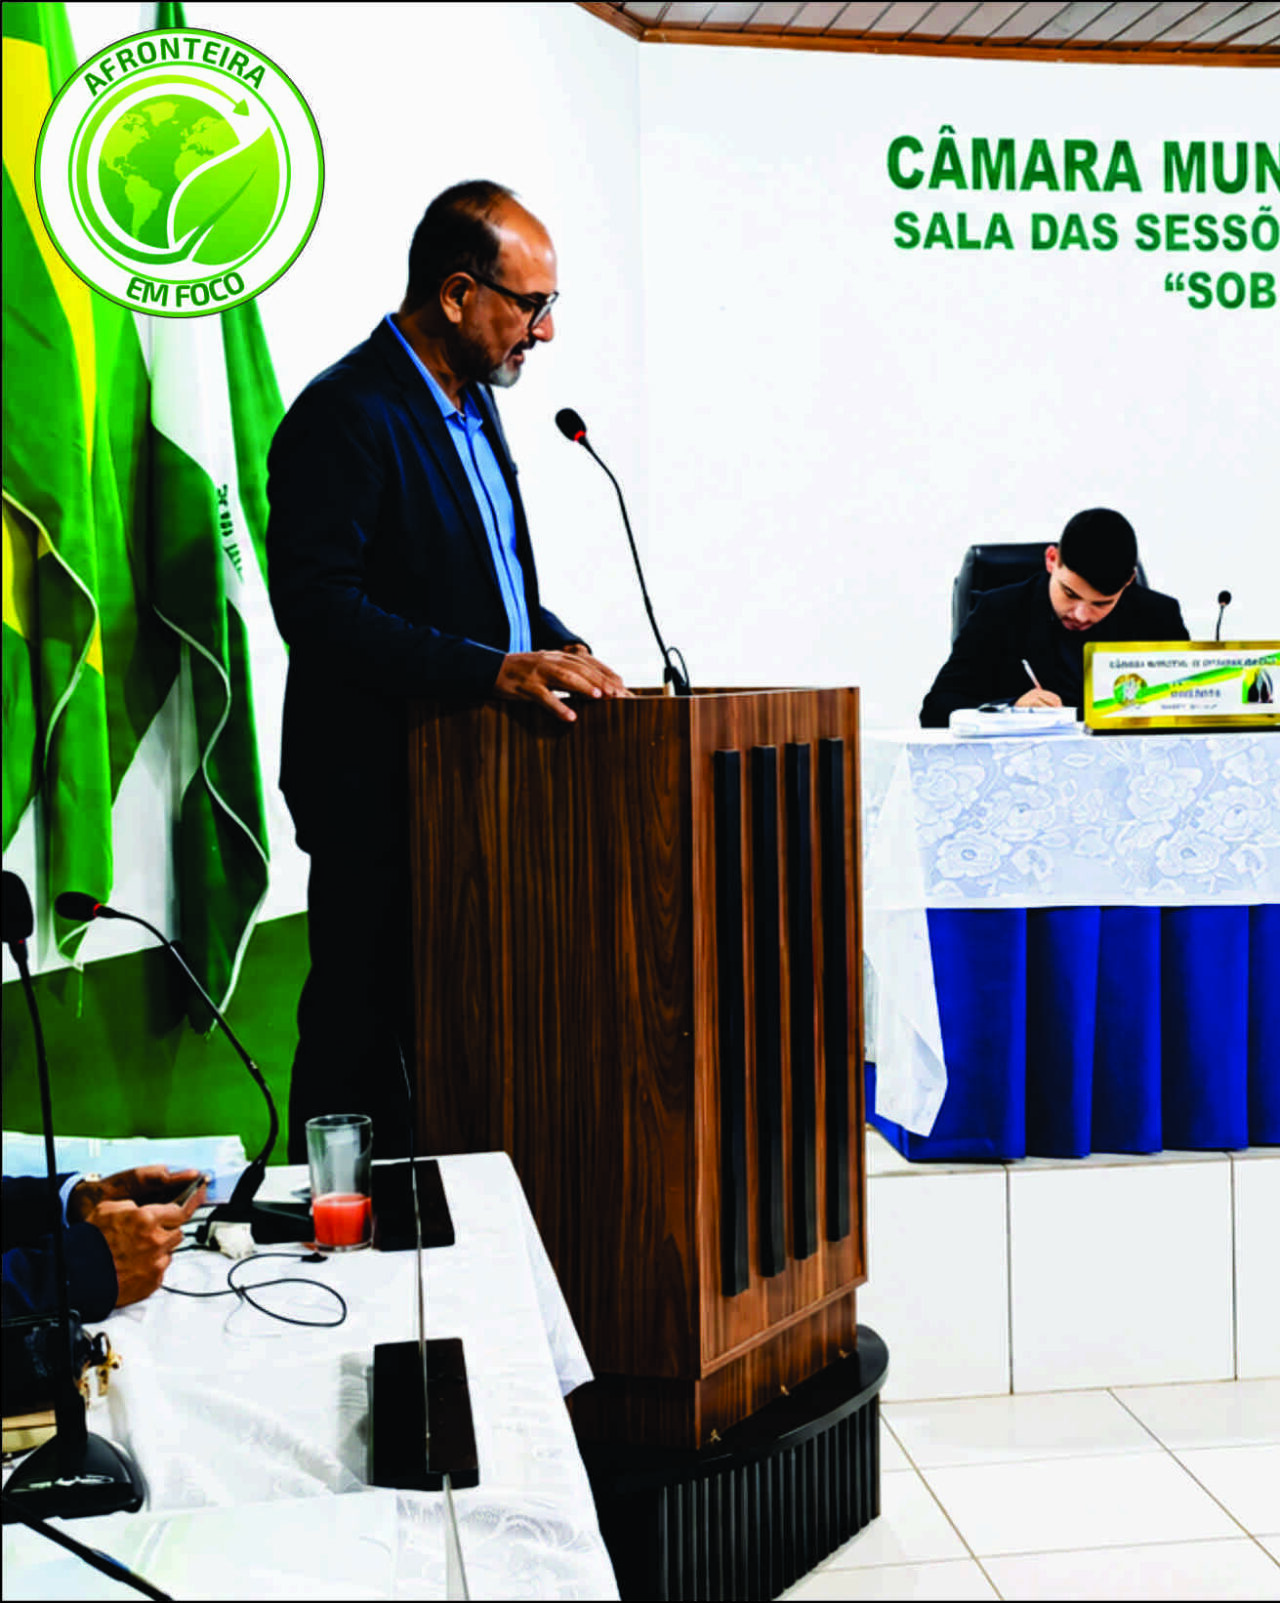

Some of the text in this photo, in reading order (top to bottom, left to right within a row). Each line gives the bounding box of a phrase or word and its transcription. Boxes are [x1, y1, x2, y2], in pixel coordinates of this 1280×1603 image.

[886, 124, 1143, 193] CÂMARA
[893, 211, 1015, 251] SALA
[1031, 213, 1119, 251] DAS
